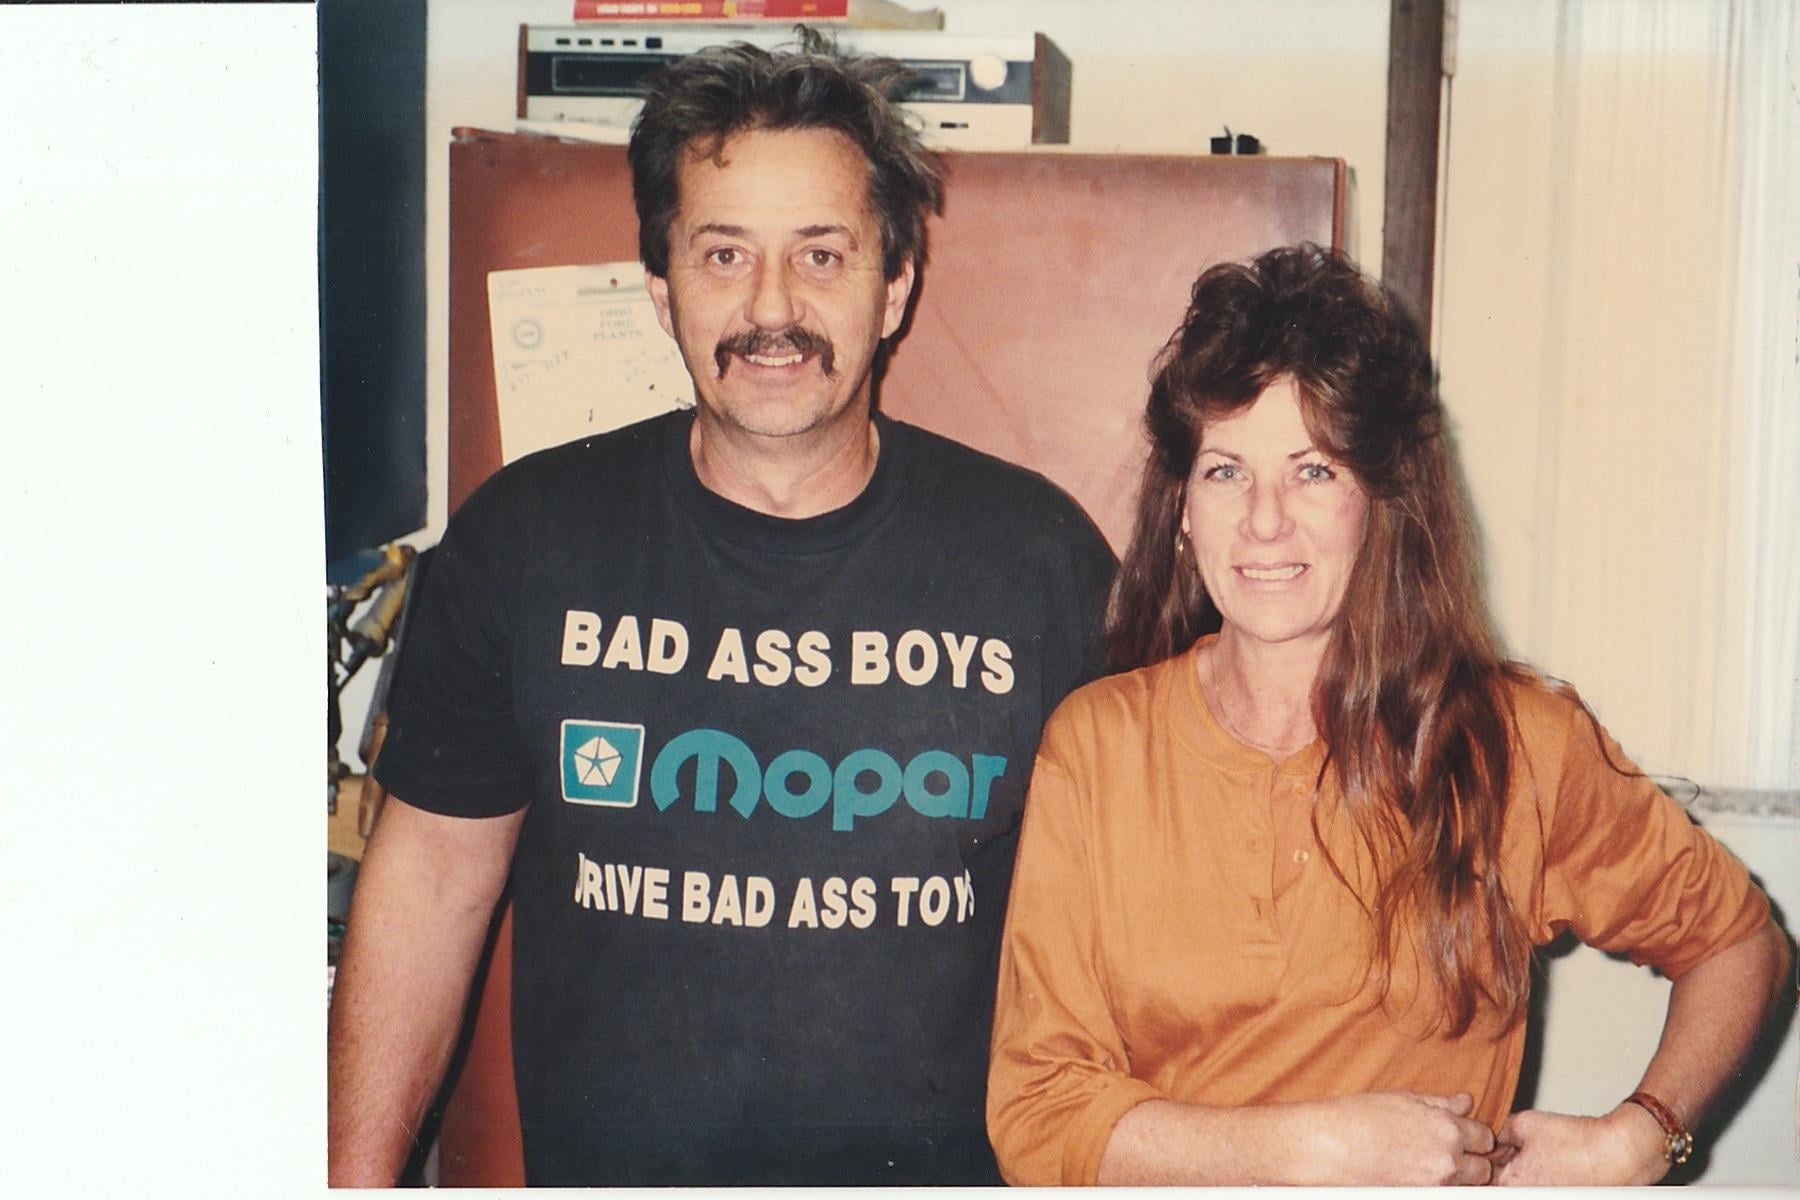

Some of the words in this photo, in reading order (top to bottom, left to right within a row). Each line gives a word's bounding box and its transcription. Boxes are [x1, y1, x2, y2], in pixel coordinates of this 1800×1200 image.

[561, 609, 690, 675] BAD
[706, 627, 832, 688] ASS
[850, 629, 1015, 695] BOYS
[682, 871, 776, 928] BAD
[787, 876, 877, 930] ASS
